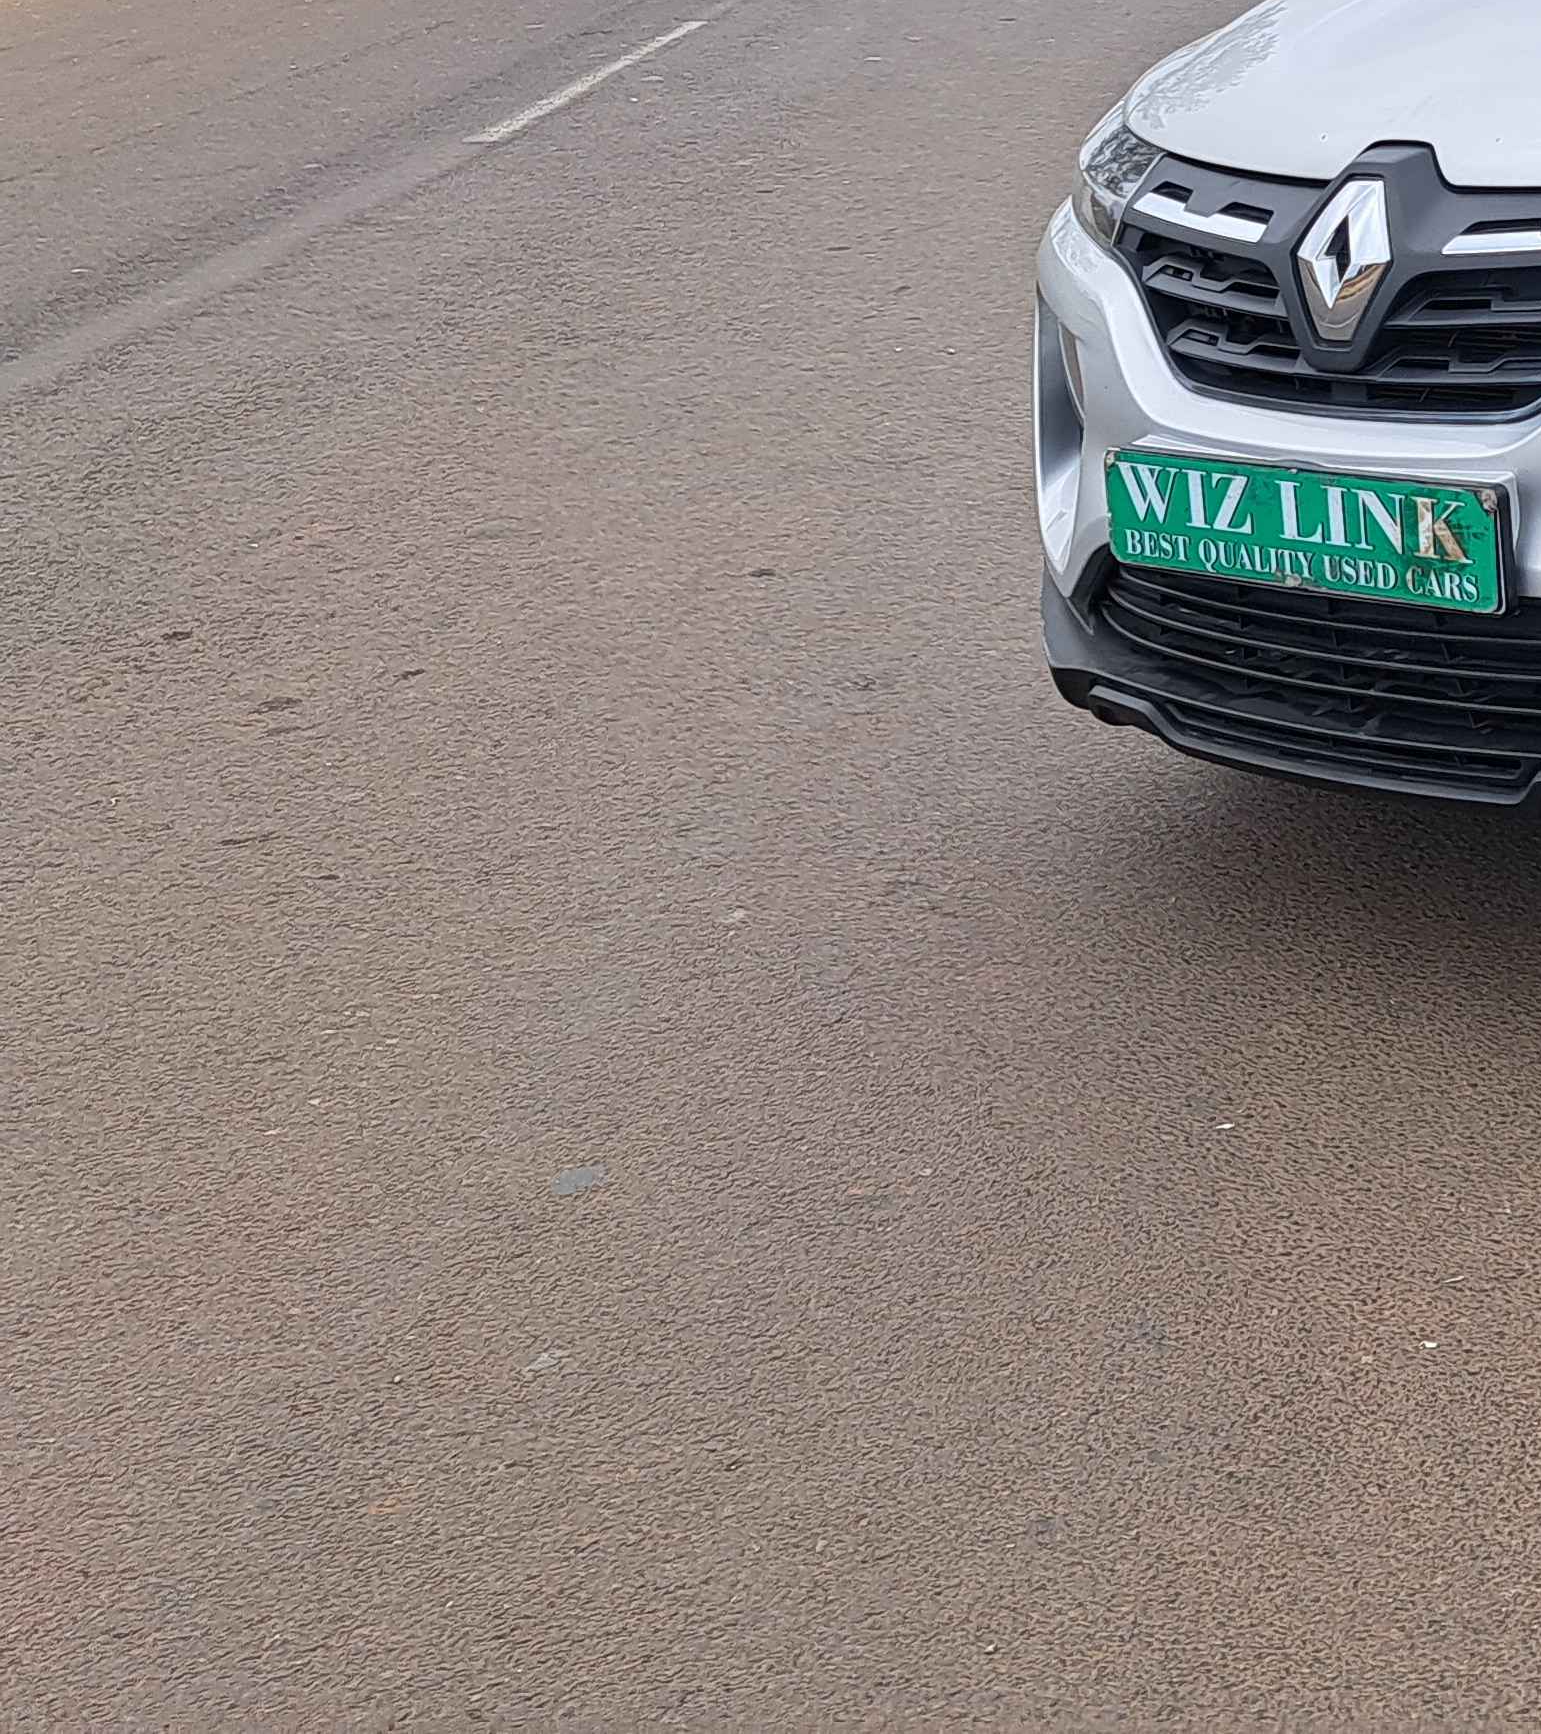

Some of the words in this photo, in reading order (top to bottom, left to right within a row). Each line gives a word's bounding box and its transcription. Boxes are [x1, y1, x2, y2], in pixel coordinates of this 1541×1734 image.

[1113, 461, 1253, 535] WIZ
[1276, 478, 1474, 566] LINK
[1123, 528, 1192, 563] BEST
[1198, 538, 1313, 586] QUALITY
[1323, 555, 1397, 591] USED
[1406, 567, 1480, 604] CARS
